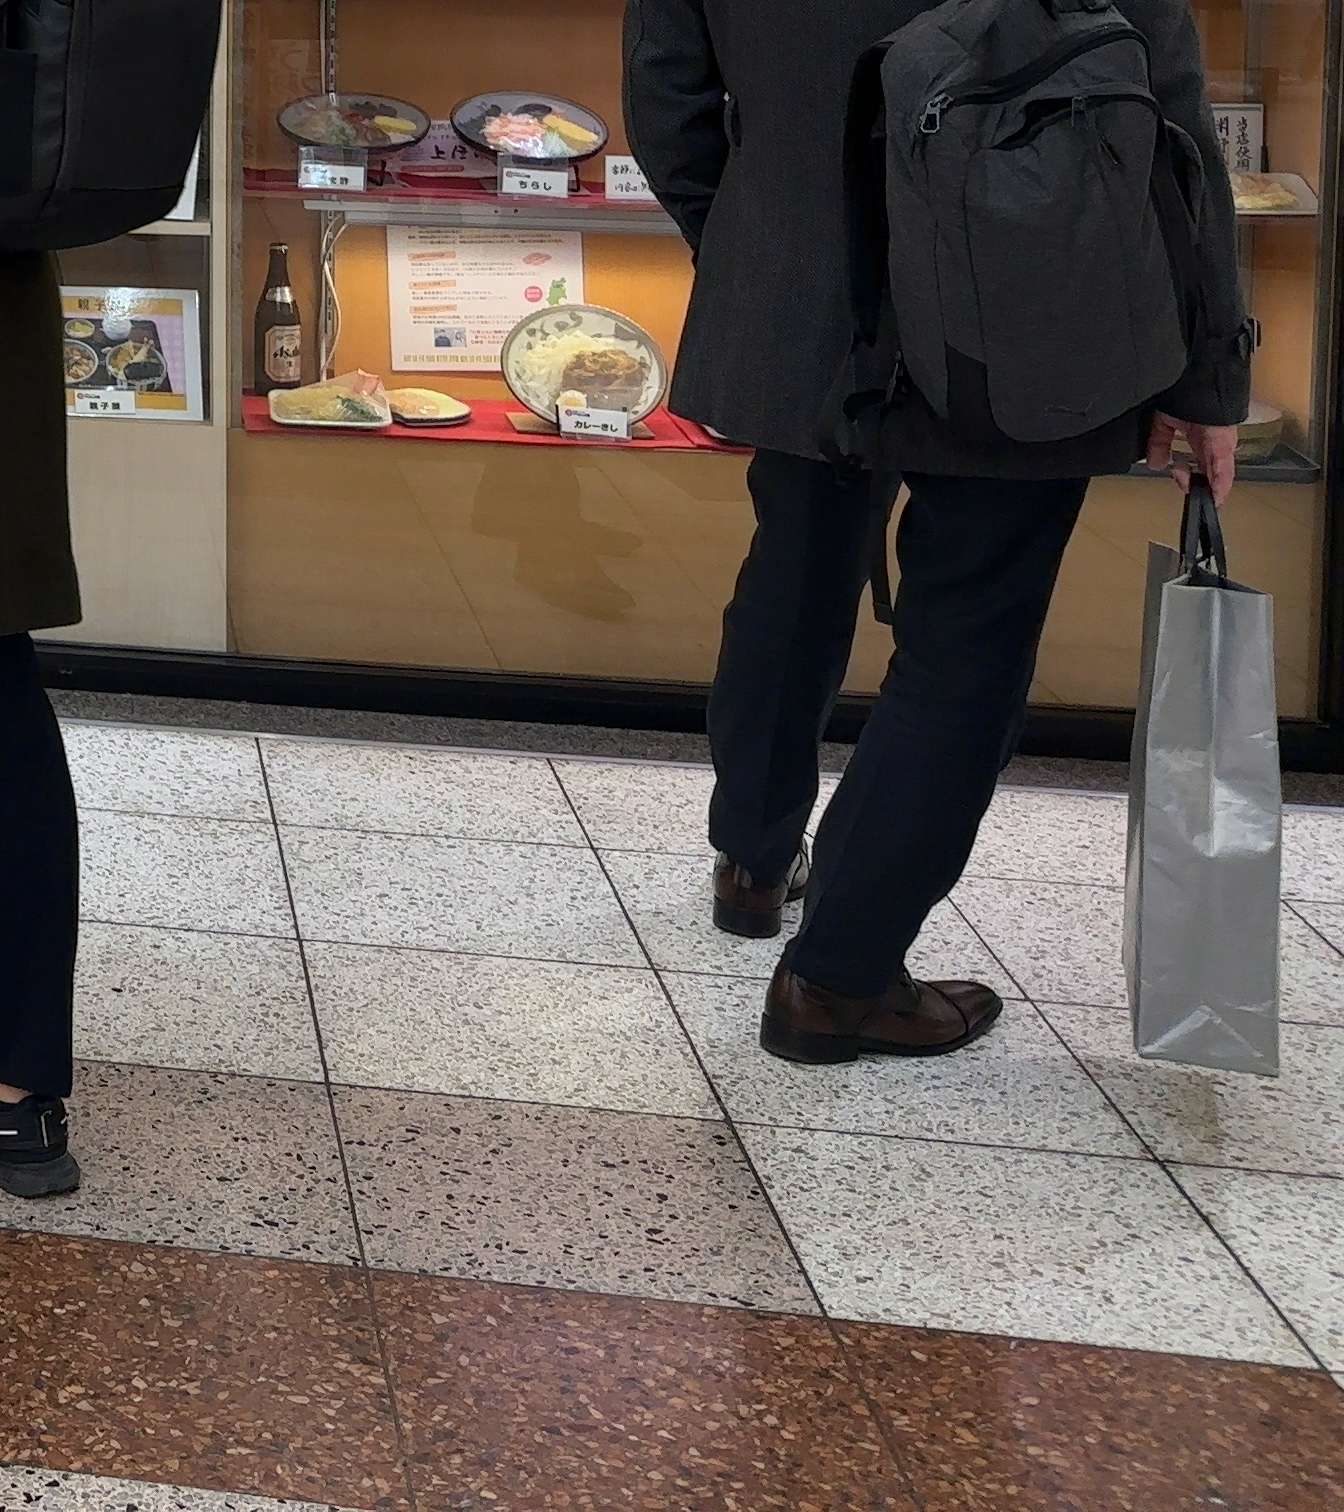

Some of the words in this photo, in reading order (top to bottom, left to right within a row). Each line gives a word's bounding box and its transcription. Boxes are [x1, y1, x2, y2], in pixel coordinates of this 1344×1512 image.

[518, 180, 552, 191] ちらし
[574, 420, 618, 433] カレーきし
